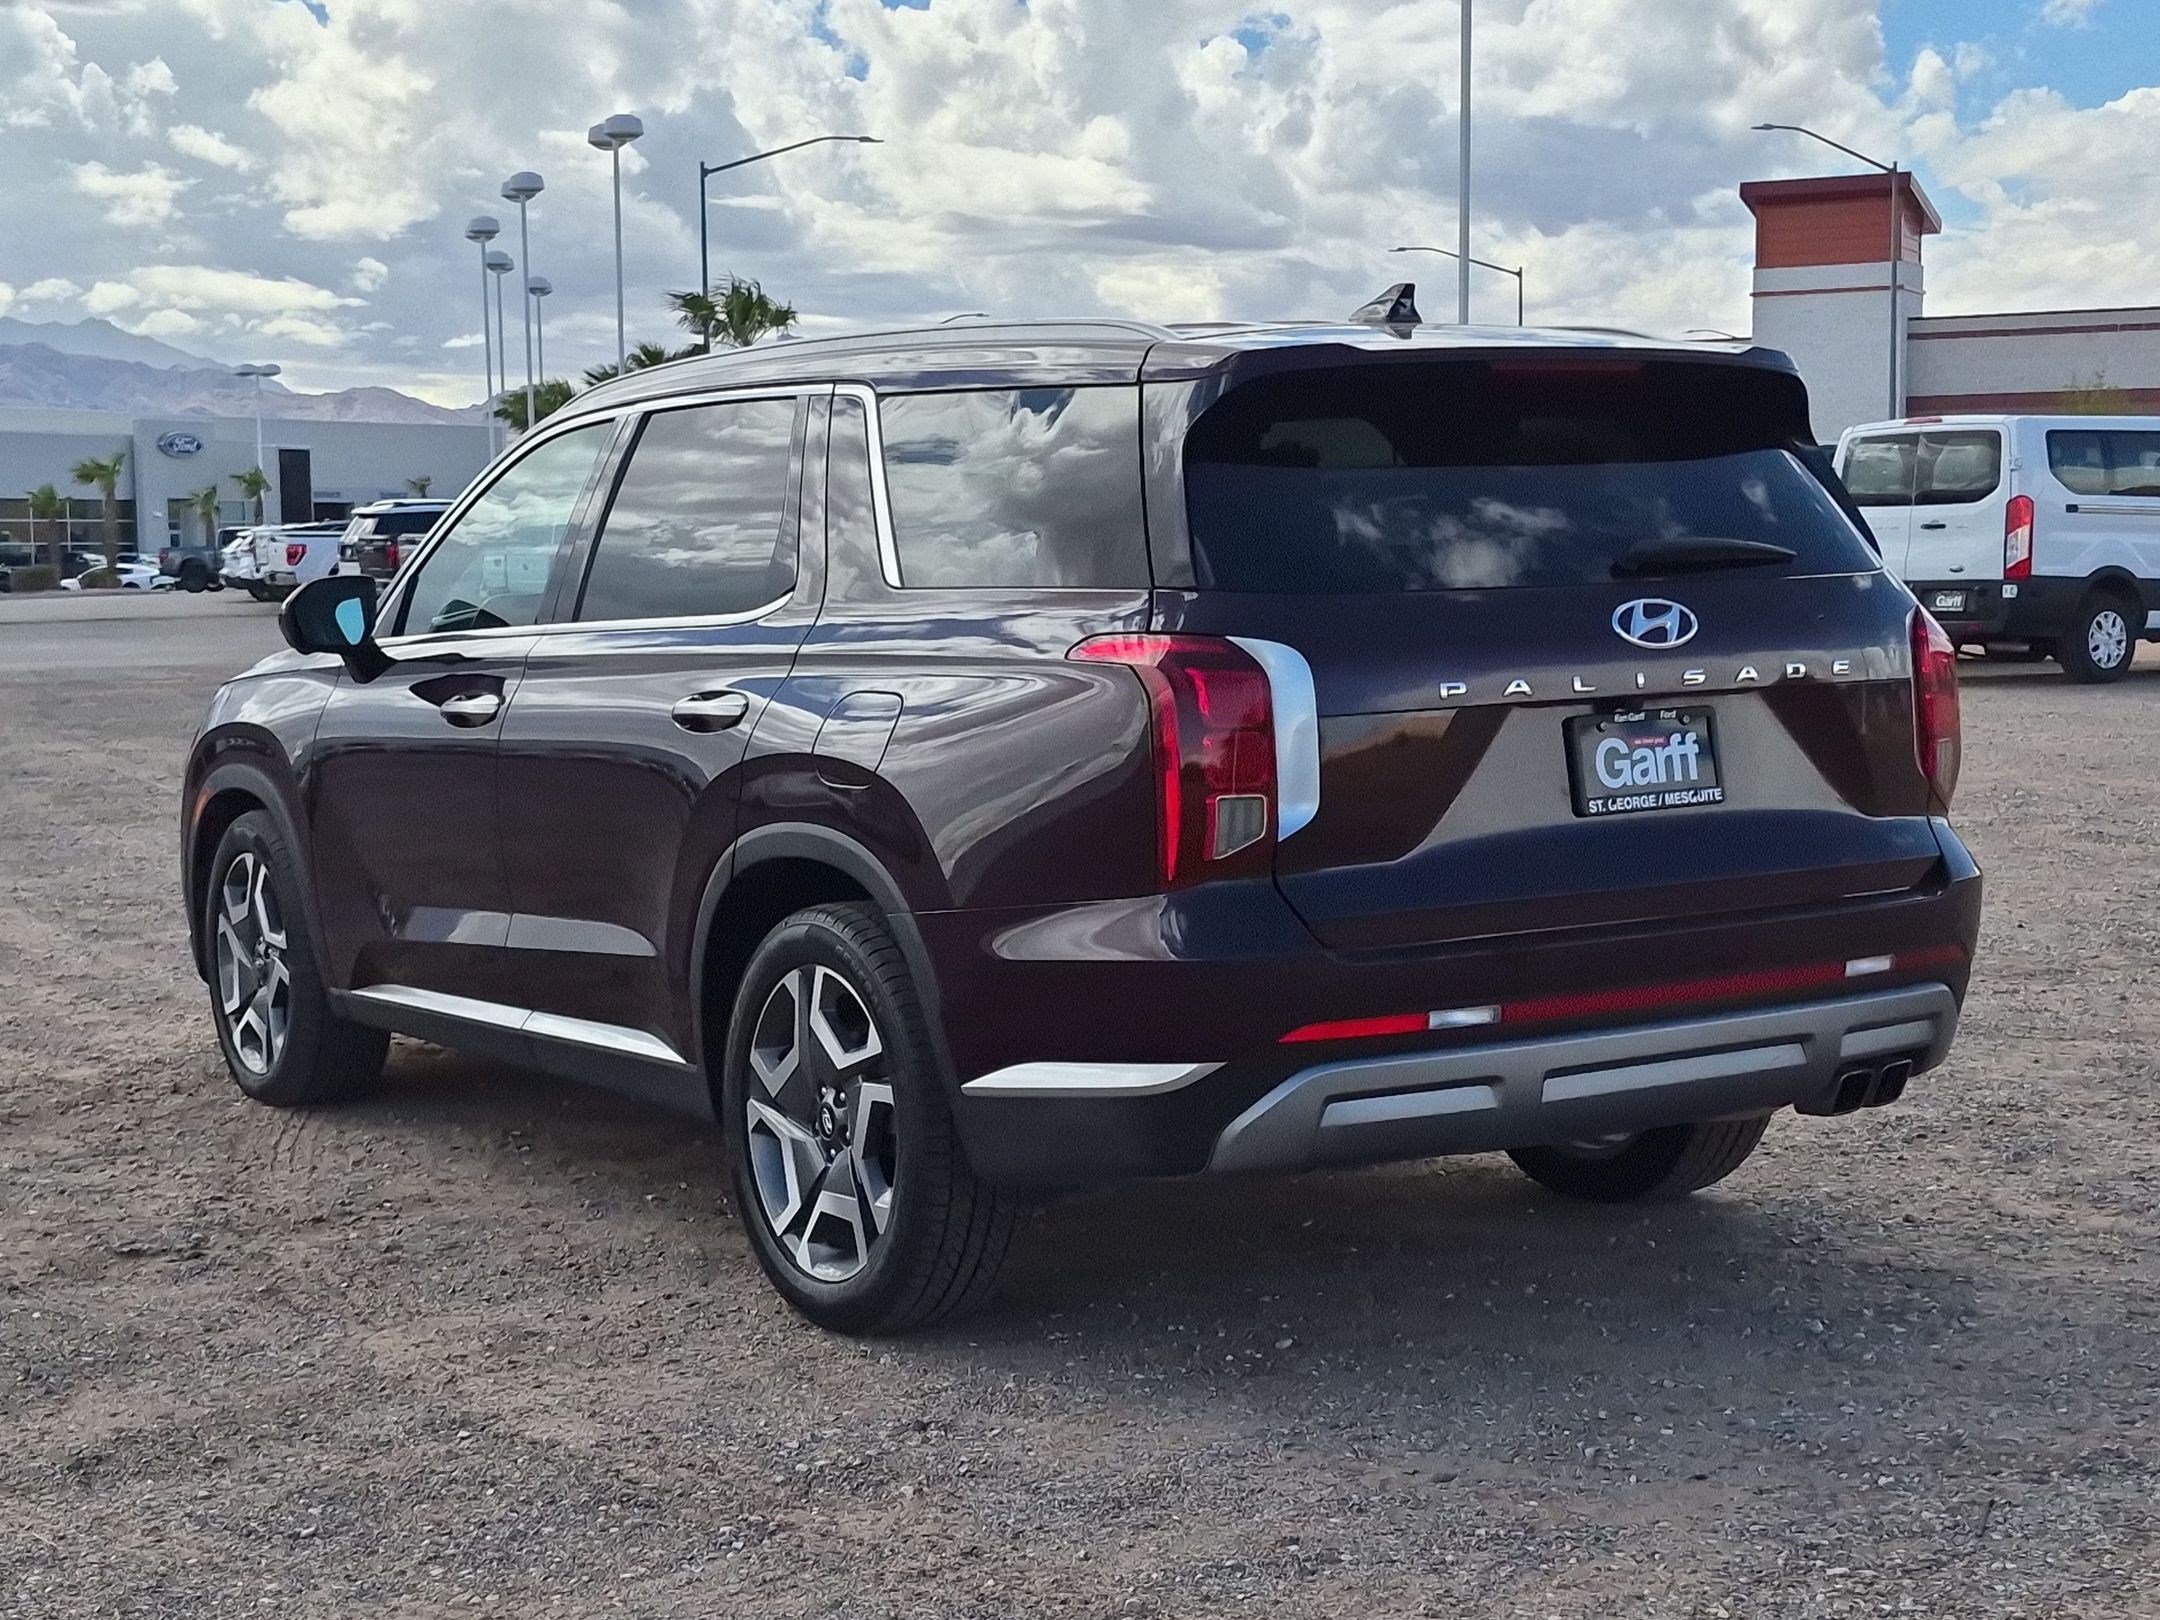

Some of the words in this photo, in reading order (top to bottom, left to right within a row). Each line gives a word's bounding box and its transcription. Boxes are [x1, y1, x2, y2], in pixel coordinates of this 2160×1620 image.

[1439, 659, 1851, 699] PALISADE
[1660, 710, 1677, 720] Ford
[1595, 731, 1700, 790] Garff
[1588, 800, 1606, 814] ST.
[1608, 794, 1657, 811] GEORGE
[1664, 788, 1723, 806] MESQUITE
